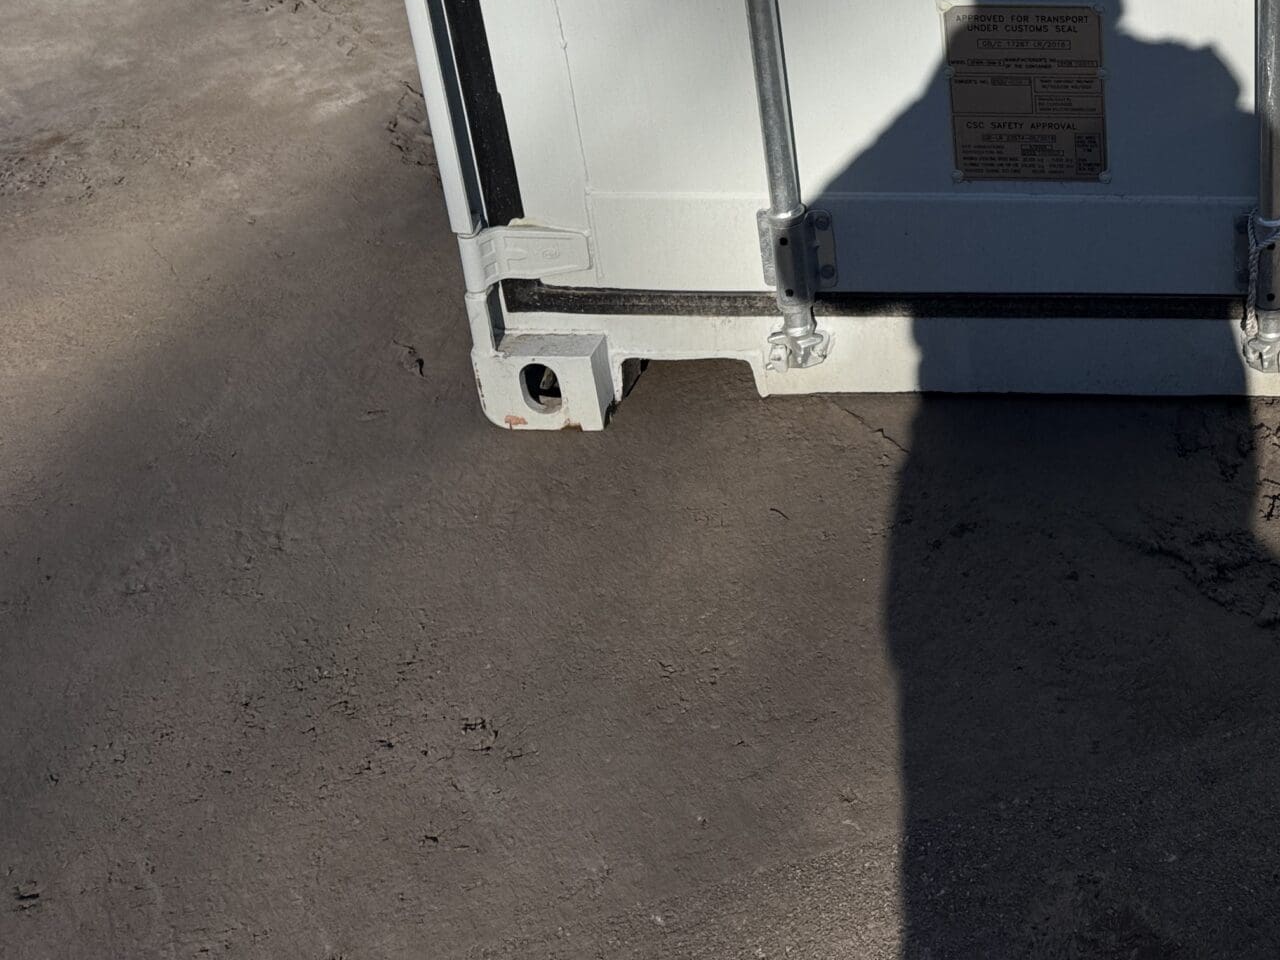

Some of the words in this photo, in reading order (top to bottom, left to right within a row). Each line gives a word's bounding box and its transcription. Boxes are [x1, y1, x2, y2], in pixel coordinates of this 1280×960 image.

[955, 14, 1005, 24] APPROVED
[1010, 15, 1029, 24] FOR
[1035, 15, 1089, 24] TRANSPORT
[967, 24, 999, 33] UNDER
[1004, 24, 1049, 33] CUSTOMS
[1055, 24, 1078, 33] SEAL
[966, 121, 985, 130] CSC
[990, 122, 1024, 130] SAFETY
[1030, 122, 1077, 131] APPROVAL
